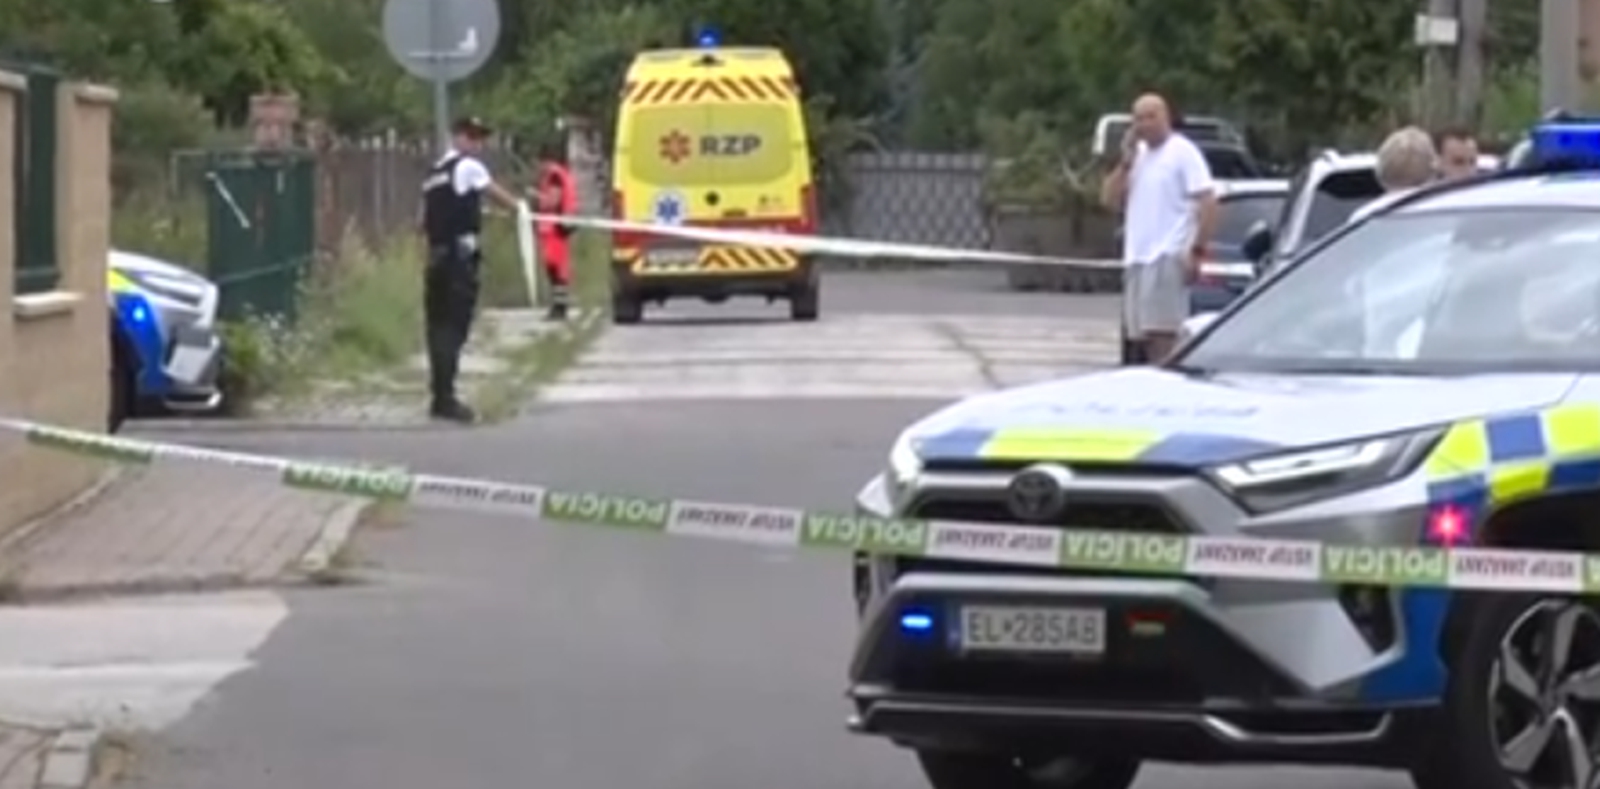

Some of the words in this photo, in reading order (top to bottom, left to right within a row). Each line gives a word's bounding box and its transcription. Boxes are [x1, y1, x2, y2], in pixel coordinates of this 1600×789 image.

[701, 135, 762, 156] RZP
[550, 492, 666, 523] POLÍCIA
[808, 516, 925, 547] POLÍCIA
[1067, 534, 1184, 564] POLÍCIA
[1327, 547, 1443, 577] POLÍCIA
